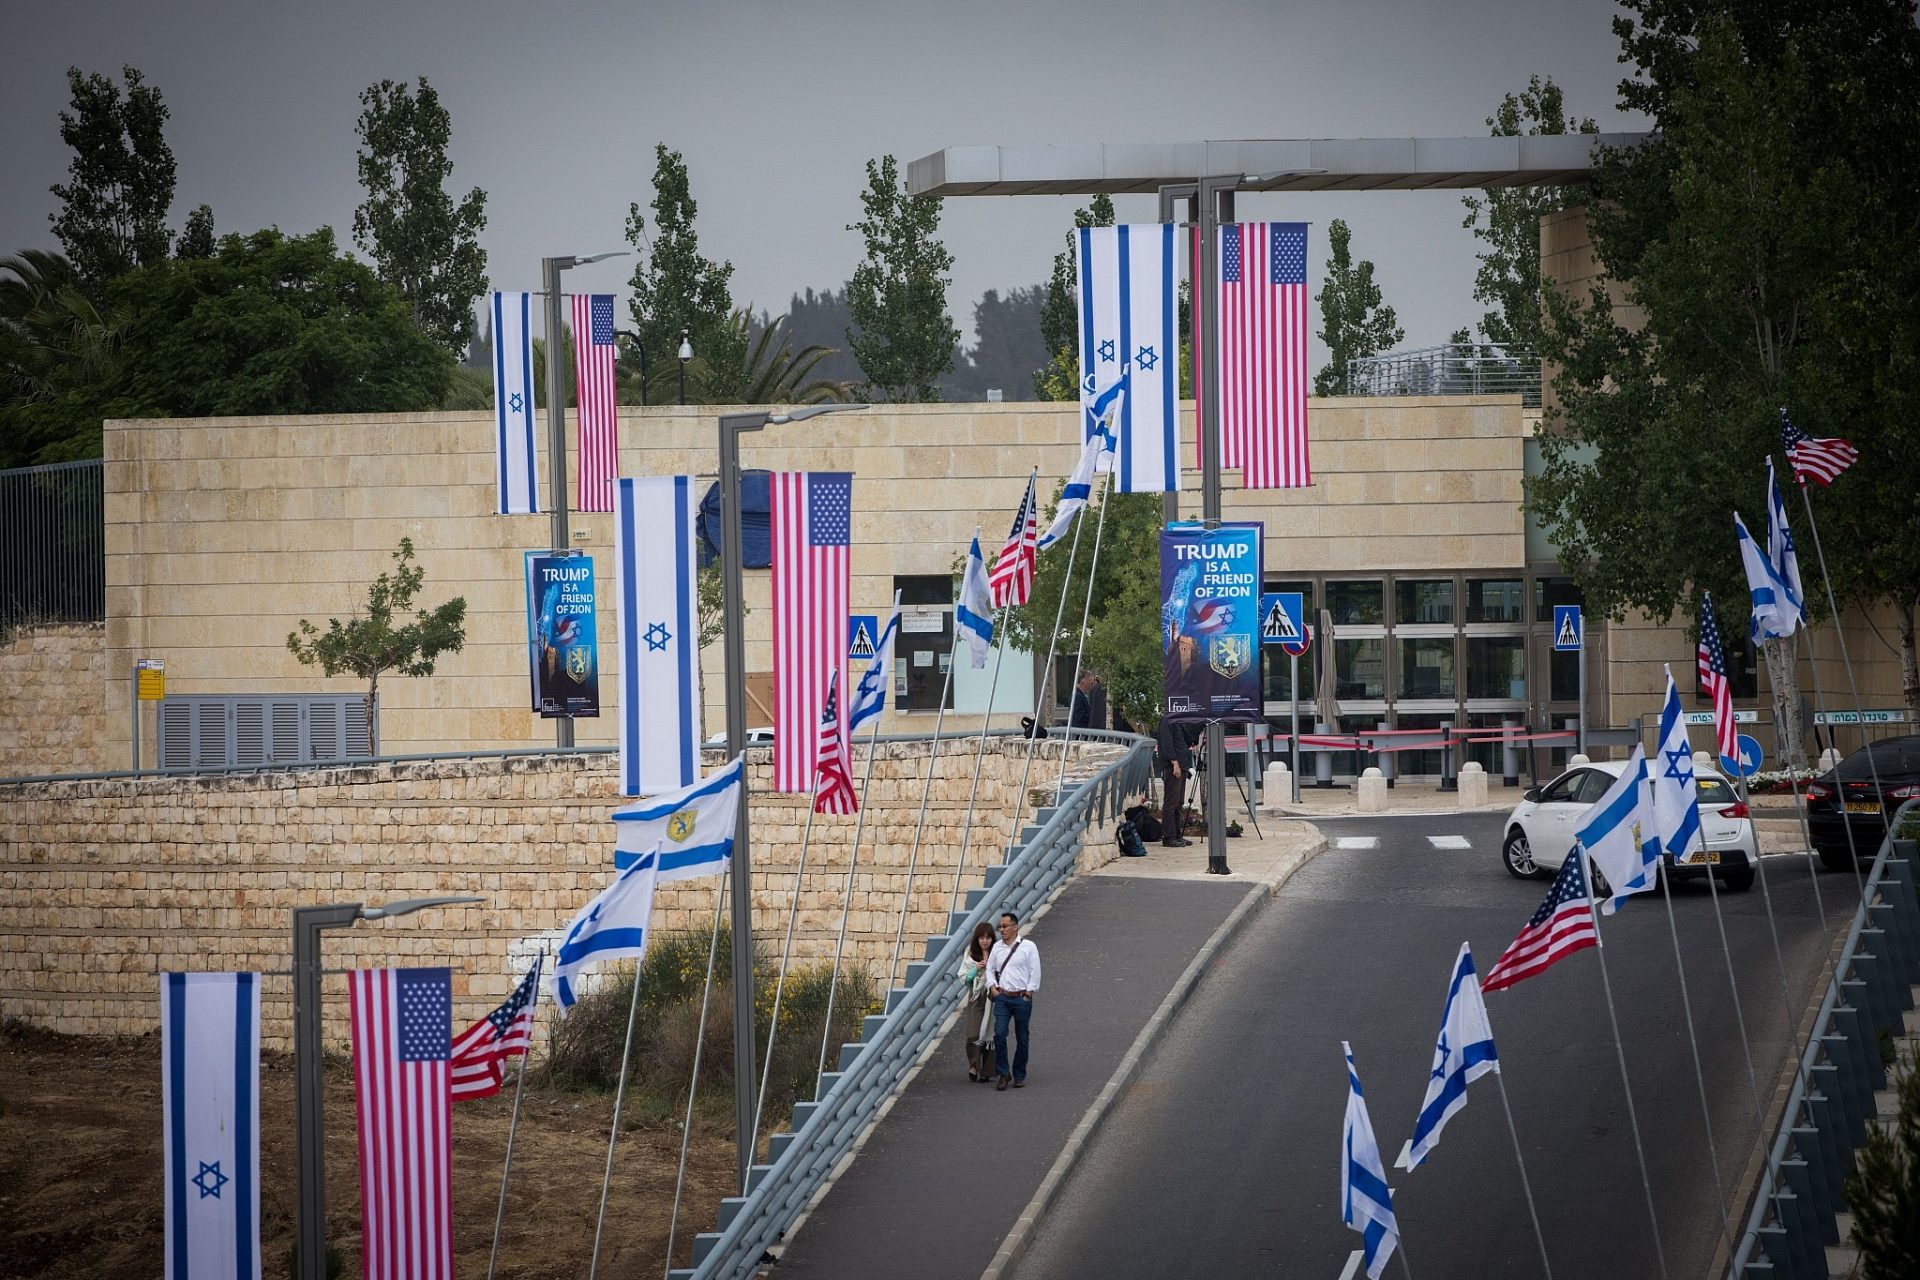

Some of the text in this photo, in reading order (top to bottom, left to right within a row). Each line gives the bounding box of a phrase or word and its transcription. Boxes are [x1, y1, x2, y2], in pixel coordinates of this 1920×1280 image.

[1173, 543, 1249, 560] TRUMP
[1206, 561, 1230, 572] IS A
[542, 568, 590, 582] TRUMP
[1203, 573, 1254, 585] FRIEND
[562, 583, 579, 593] IS A
[1194, 586, 1250, 598] OF ZION
[561, 593, 594, 603] FRIEND
[556, 604, 592, 614] OF ZION
